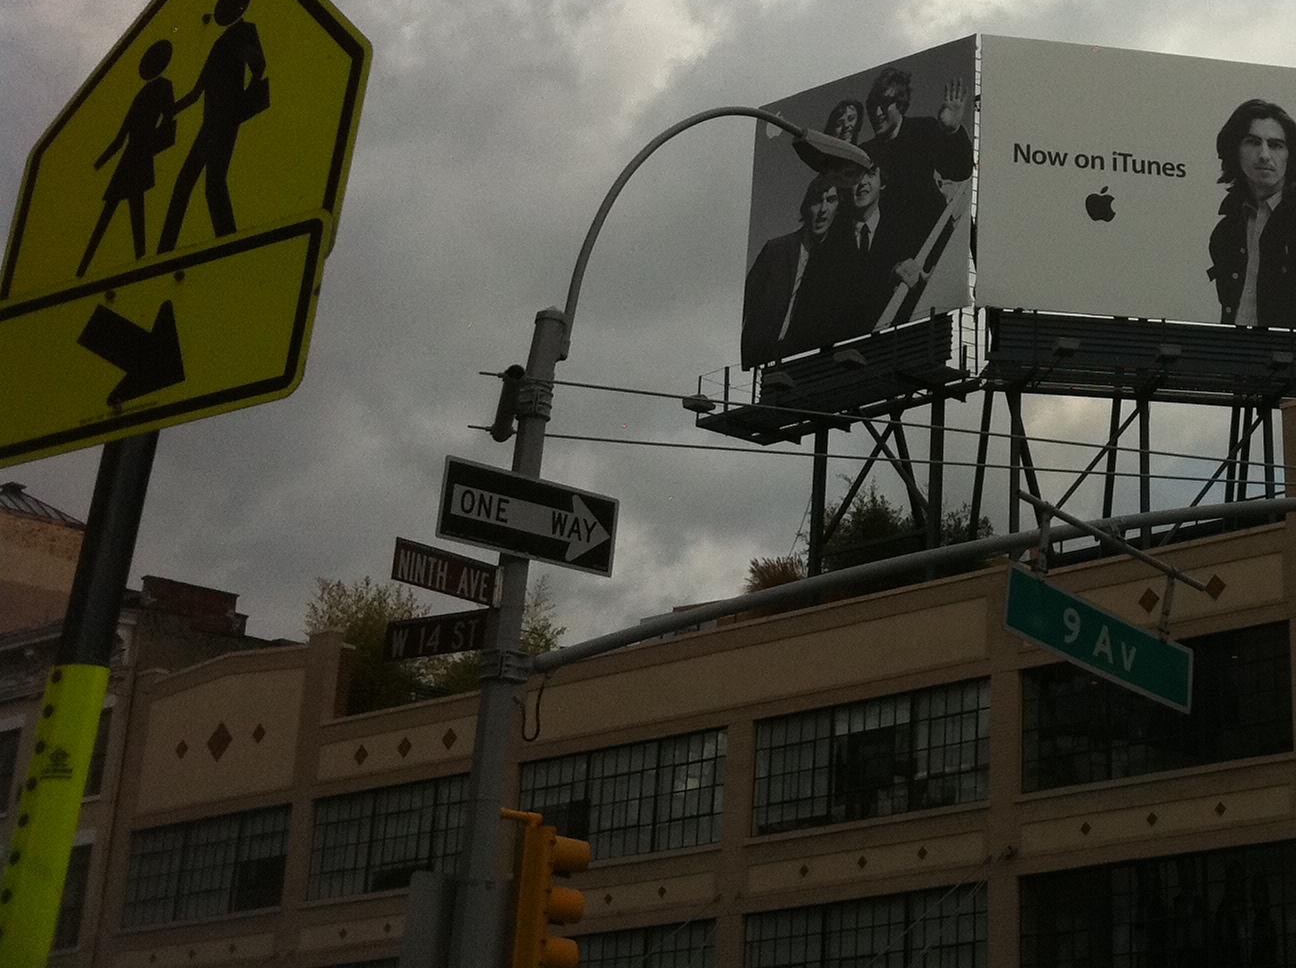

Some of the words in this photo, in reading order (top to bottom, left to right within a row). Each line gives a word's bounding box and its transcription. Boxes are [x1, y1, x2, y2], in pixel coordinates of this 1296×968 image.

[1013, 143, 1068, 167] Now
[1074, 153, 1105, 170] on
[1112, 151, 1187, 178] iTunes
[460, 489, 511, 523] ONE
[551, 510, 597, 543] WAY
[397, 548, 449, 592] NINTH
[457, 566, 491, 603] AVE
[391, 627, 410, 658] W
[418, 623, 442, 654] 14
[451, 617, 480, 649] ST
[1062, 607, 1082, 644] 9
